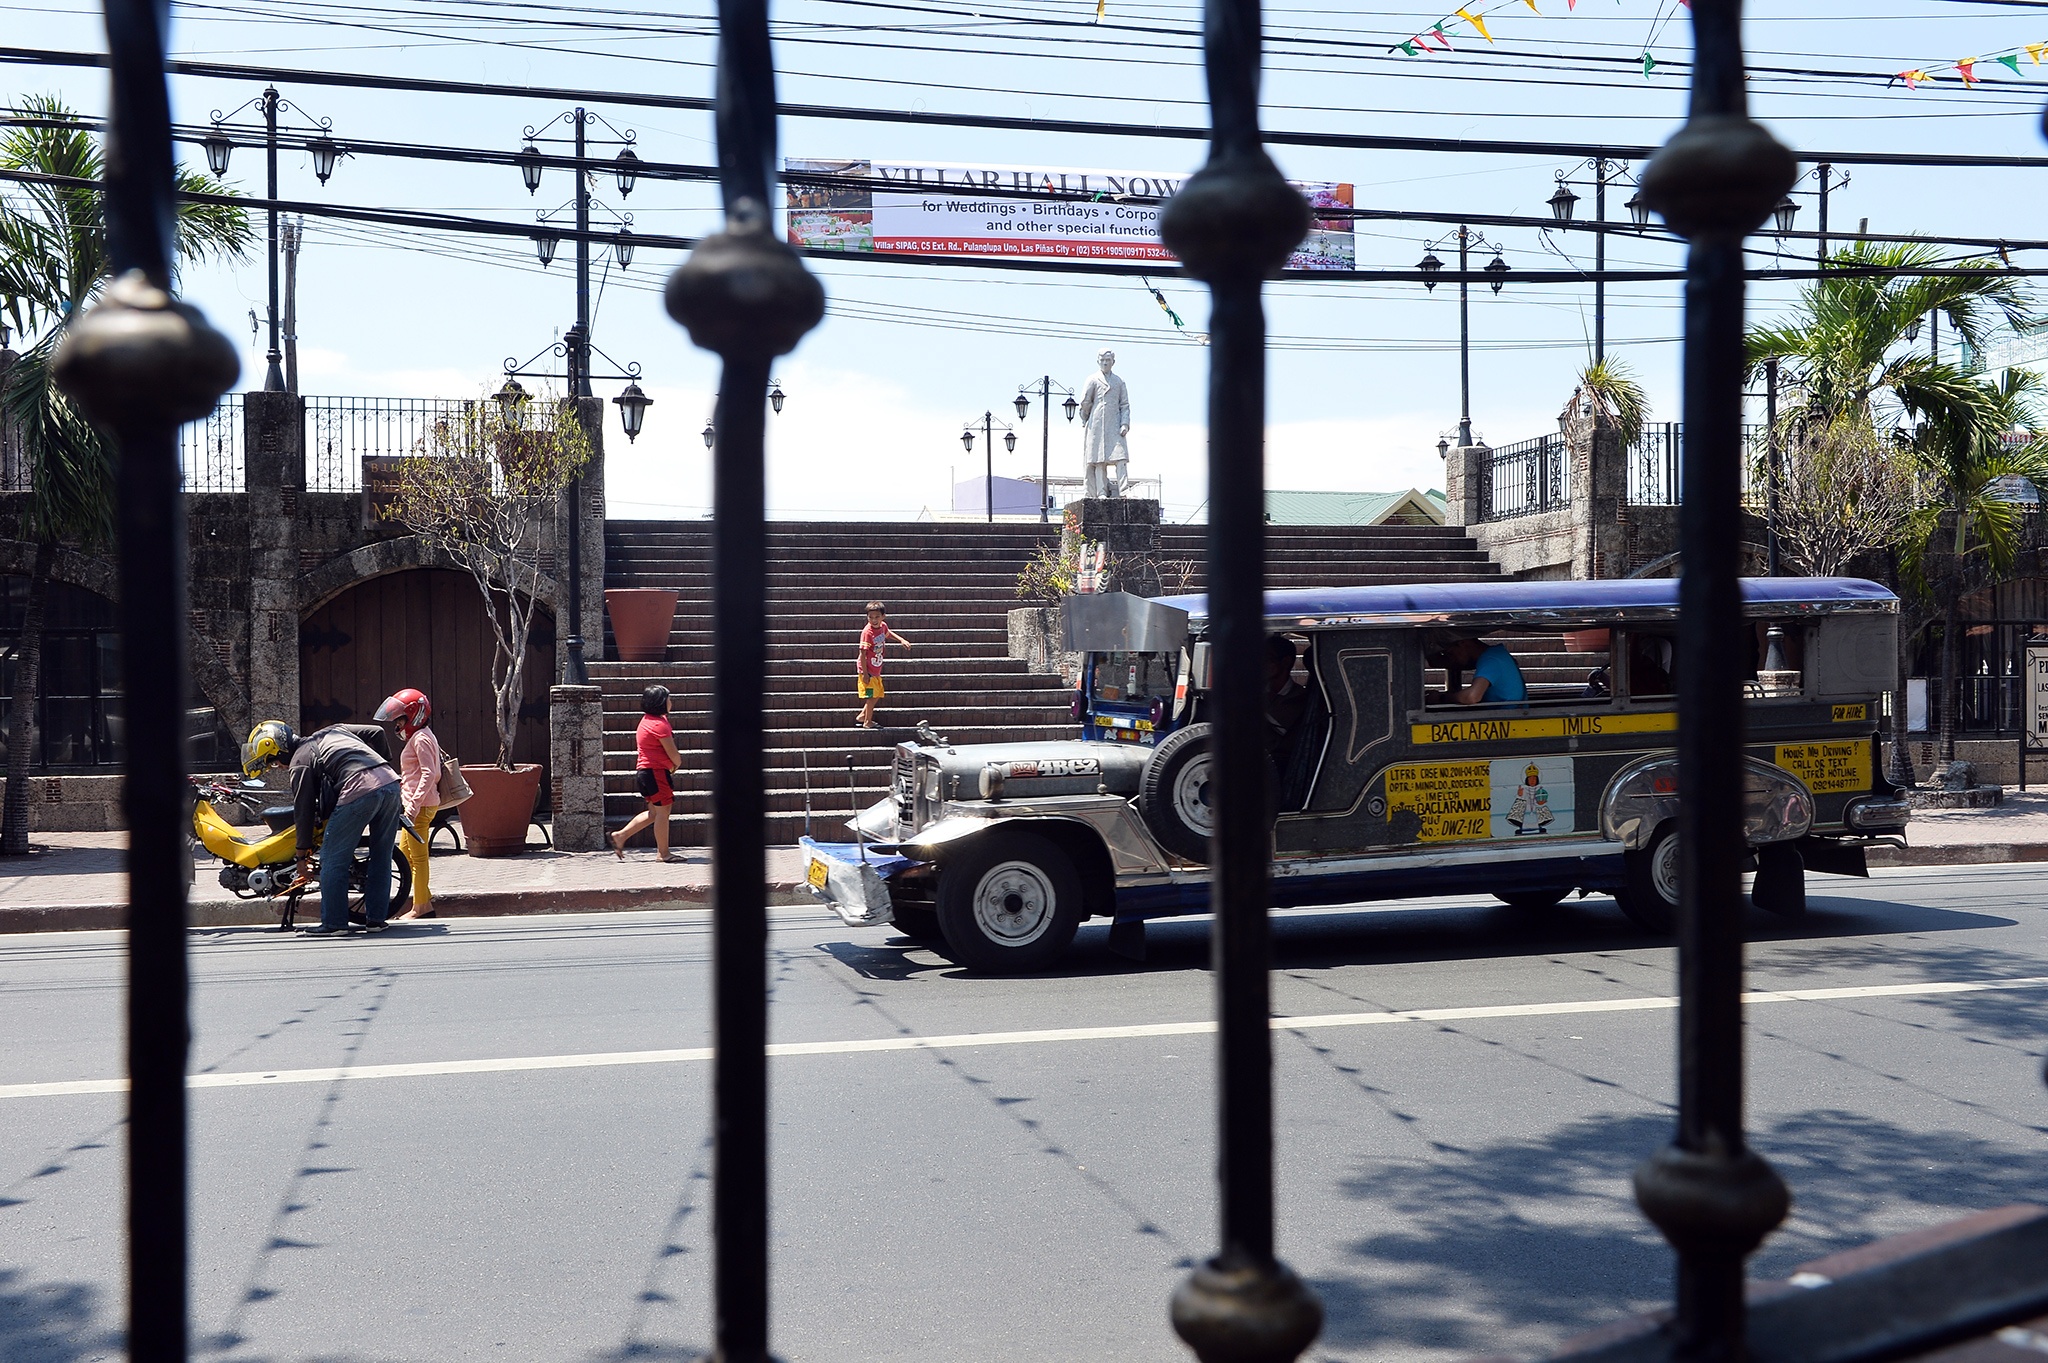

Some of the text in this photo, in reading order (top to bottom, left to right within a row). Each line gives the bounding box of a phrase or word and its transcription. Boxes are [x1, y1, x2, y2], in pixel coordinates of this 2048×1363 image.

[922, 200, 1163, 221] for Weddings Birthdays Corpor
[986, 220, 1012, 231] and
[1016, 221, 1053, 232] other
[1057, 224, 1106, 235] special
[875, 241, 894, 250] Villar
[896, 241, 920, 252] SIPAG,
[921, 242, 931, 251] C5
[932, 242, 947, 251] Ext.
[963, 242, 1002, 253] Pulanglupa
[1003, 243, 1020, 254] Uno,
[1020, 244, 1034, 252] Las
[1055, 244, 1070, 256] City
[1076, 245, 1090, 256] (02)
[1832, 705, 1864, 719] FOR HIRE
[1431, 716, 1603, 742] BACLARAN IMUS
[1792, 760, 1811, 769] CALL
[1828, 758, 1848, 767] TEXT
[1390, 768, 1416, 781] LTFRB
[1420, 767, 1438, 779] CASE
[1828, 767, 1857, 778] HOTLINE
[1425, 791, 1460, 802] IMELDA
[1441, 818, 1485, 836] DWZ-112
